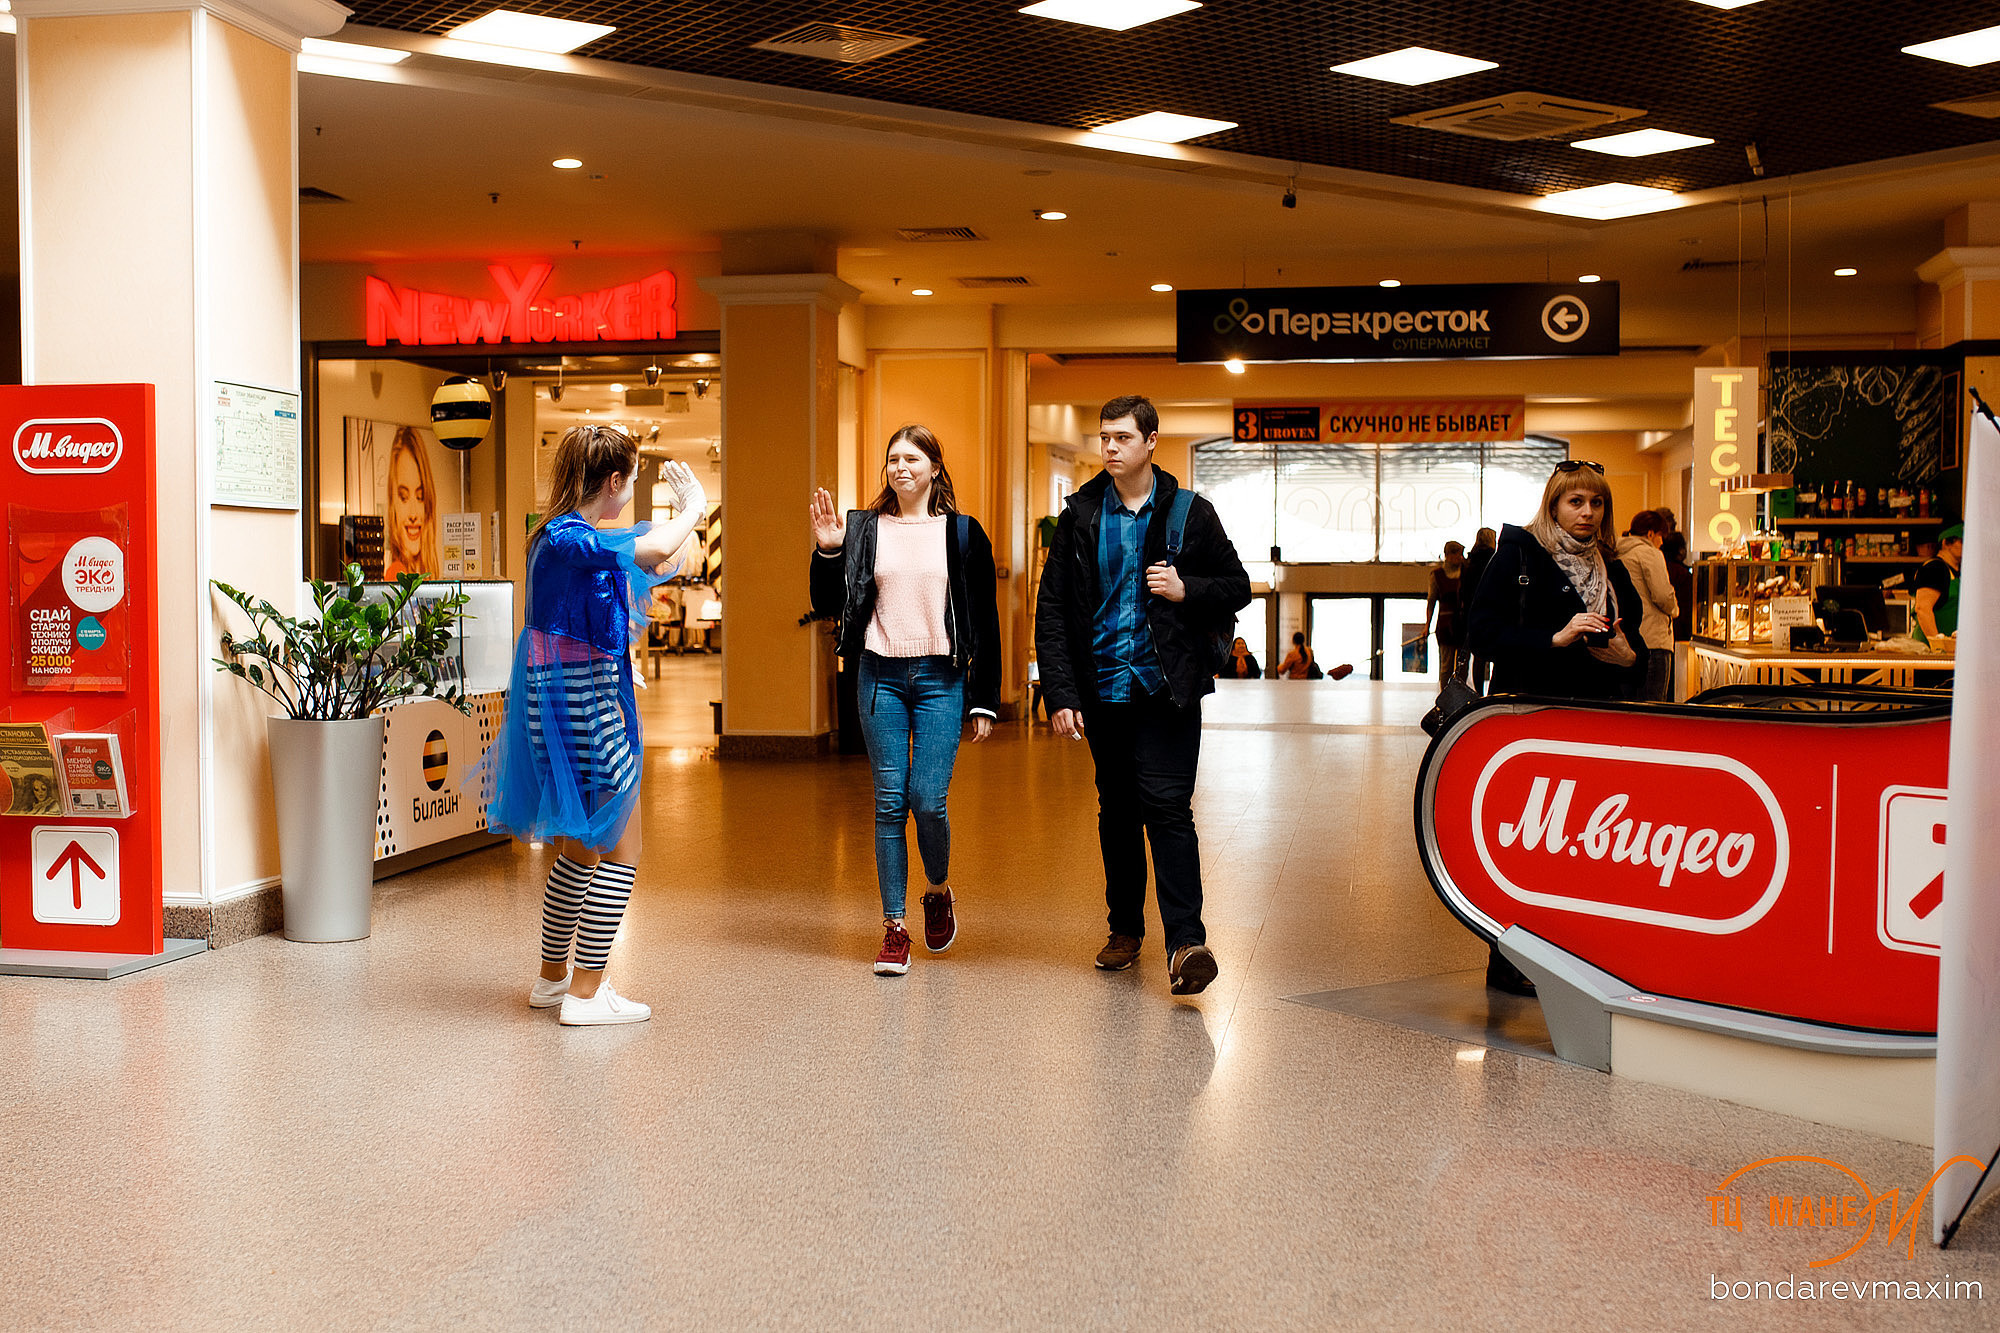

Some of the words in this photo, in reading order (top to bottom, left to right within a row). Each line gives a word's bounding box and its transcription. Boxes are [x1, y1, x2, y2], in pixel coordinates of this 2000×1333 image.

[1268, 307, 1491, 342] Перекресток
[1392, 337, 1491, 350] СУПЕРМАРКЕТ
[1238, 411, 1258, 440] 3
[1264, 427, 1316, 440] UROVEN
[1330, 415, 1401, 433] СКУЧНО
[1409, 415, 1431, 432] НЕ
[1437, 414, 1512, 432] БЫВАЕТ
[22, 432, 115, 464] М.видео
[75, 585, 115, 594] ТРЕЙД-ИН
[29, 606, 71, 622] СДАЙ
[30, 622, 71, 631] СТАРУЮ
[31, 631, 71, 639] ТЕХНИКУ
[31, 638, 37, 646] И
[38, 638, 71, 646] ПОЛУЧИ
[30, 646, 71, 655] СКИДКУ
[0, 730, 36, 738] СТАНОВКА
[412, 789, 459, 823] Билайн
[1499, 776, 1755, 888] М.видео
